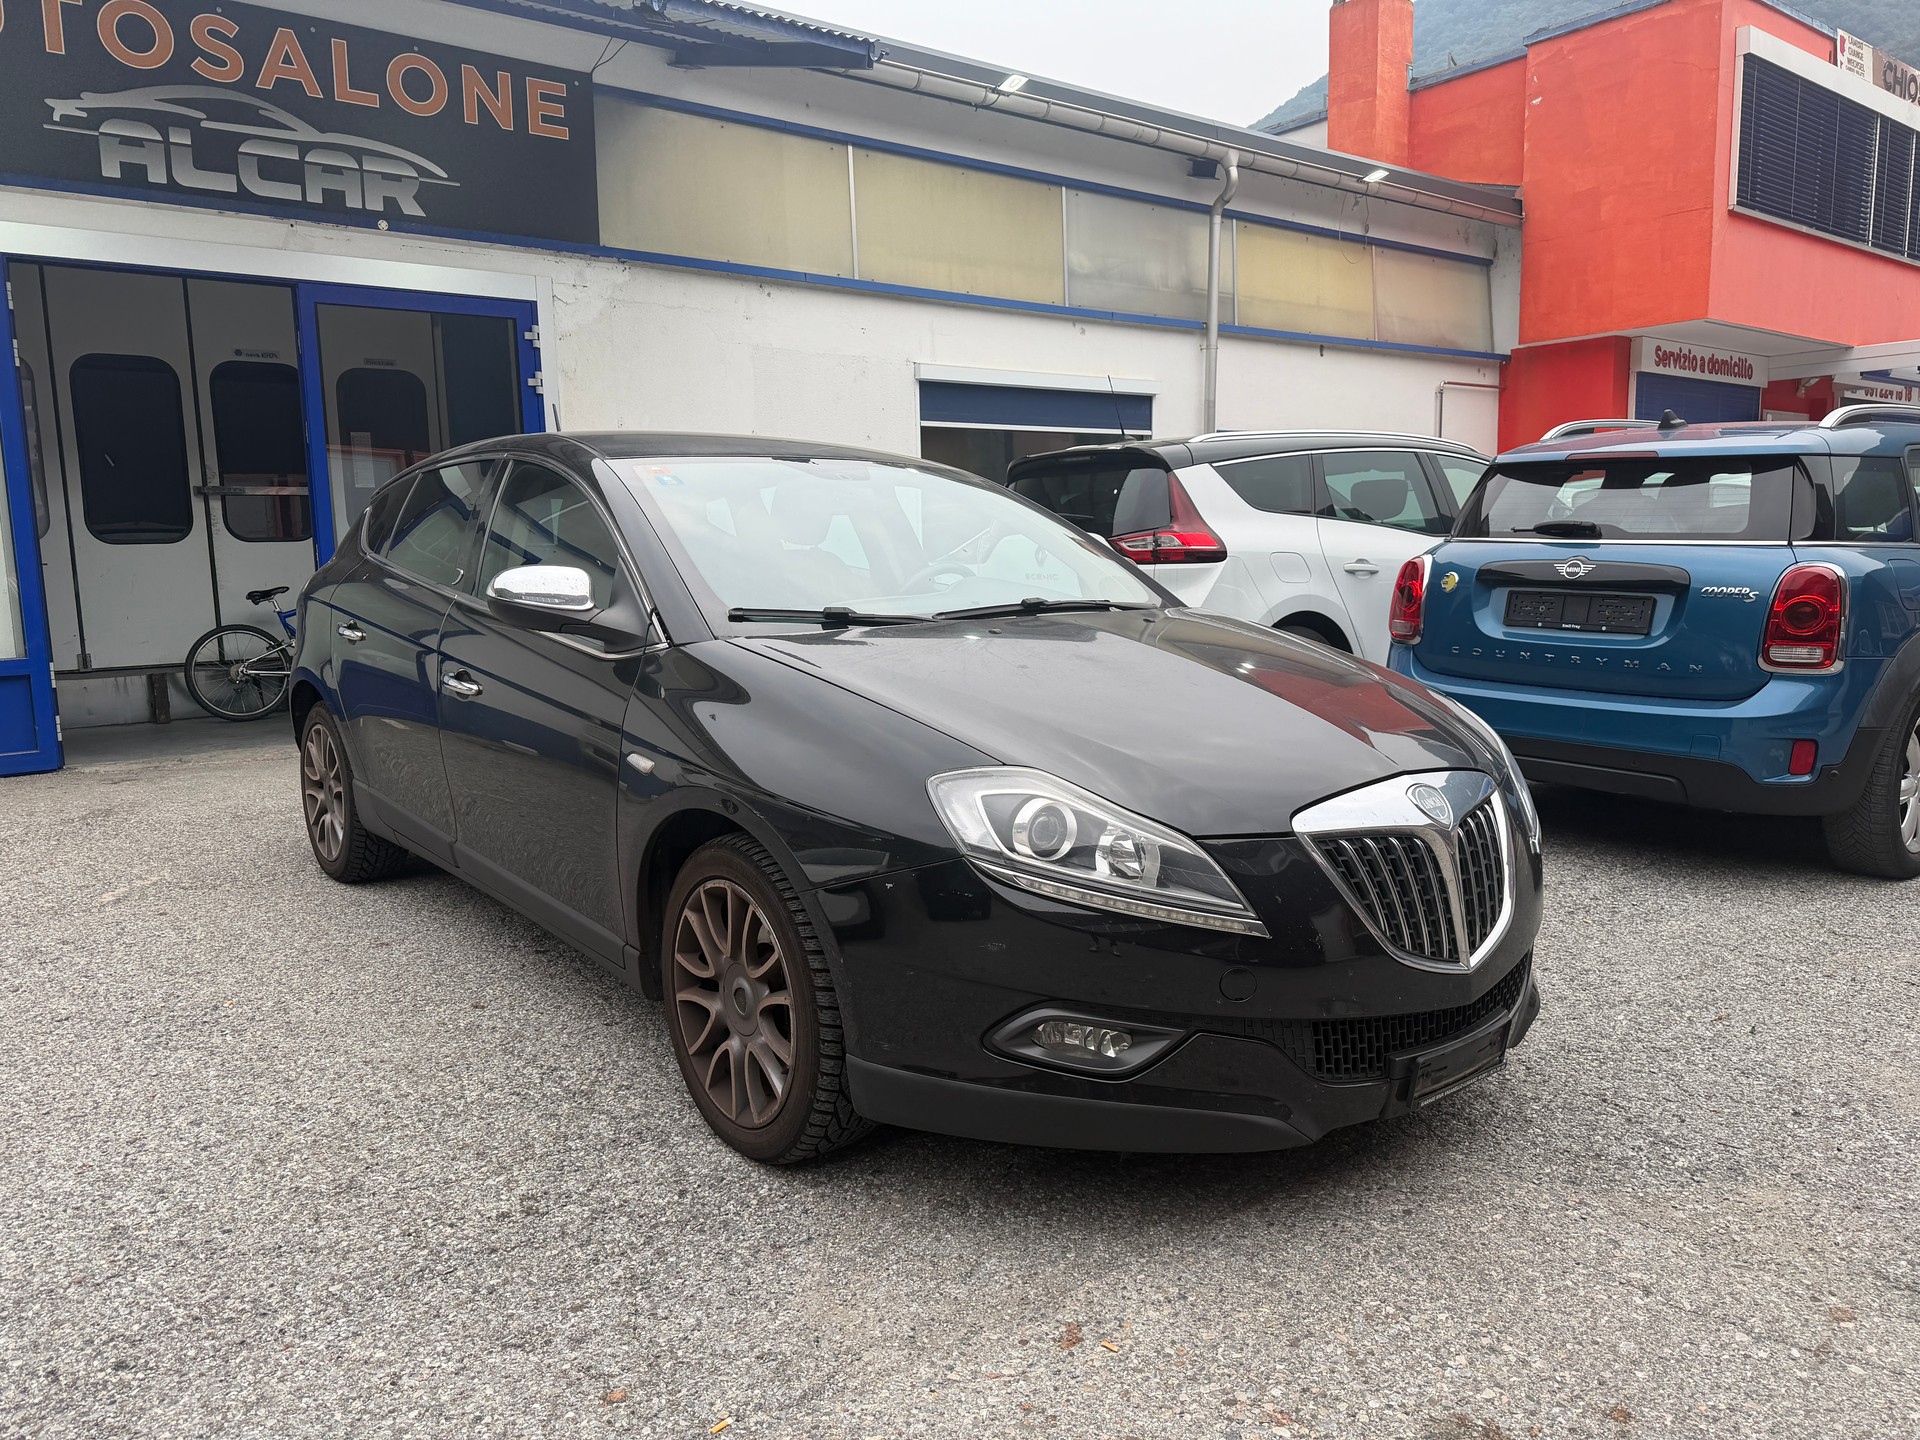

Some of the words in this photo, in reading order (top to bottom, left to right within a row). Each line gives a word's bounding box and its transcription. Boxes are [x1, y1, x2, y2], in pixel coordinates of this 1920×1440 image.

[0, 0, 570, 140] TOSALONE
[100, 118, 426, 217] ALCAR
[1654, 344, 1698, 373] Servizio
[1699, 355, 1706, 374] a
[1707, 352, 1753, 380] domicilio
[1451, 646, 1703, 673] COUNTRYMAN
